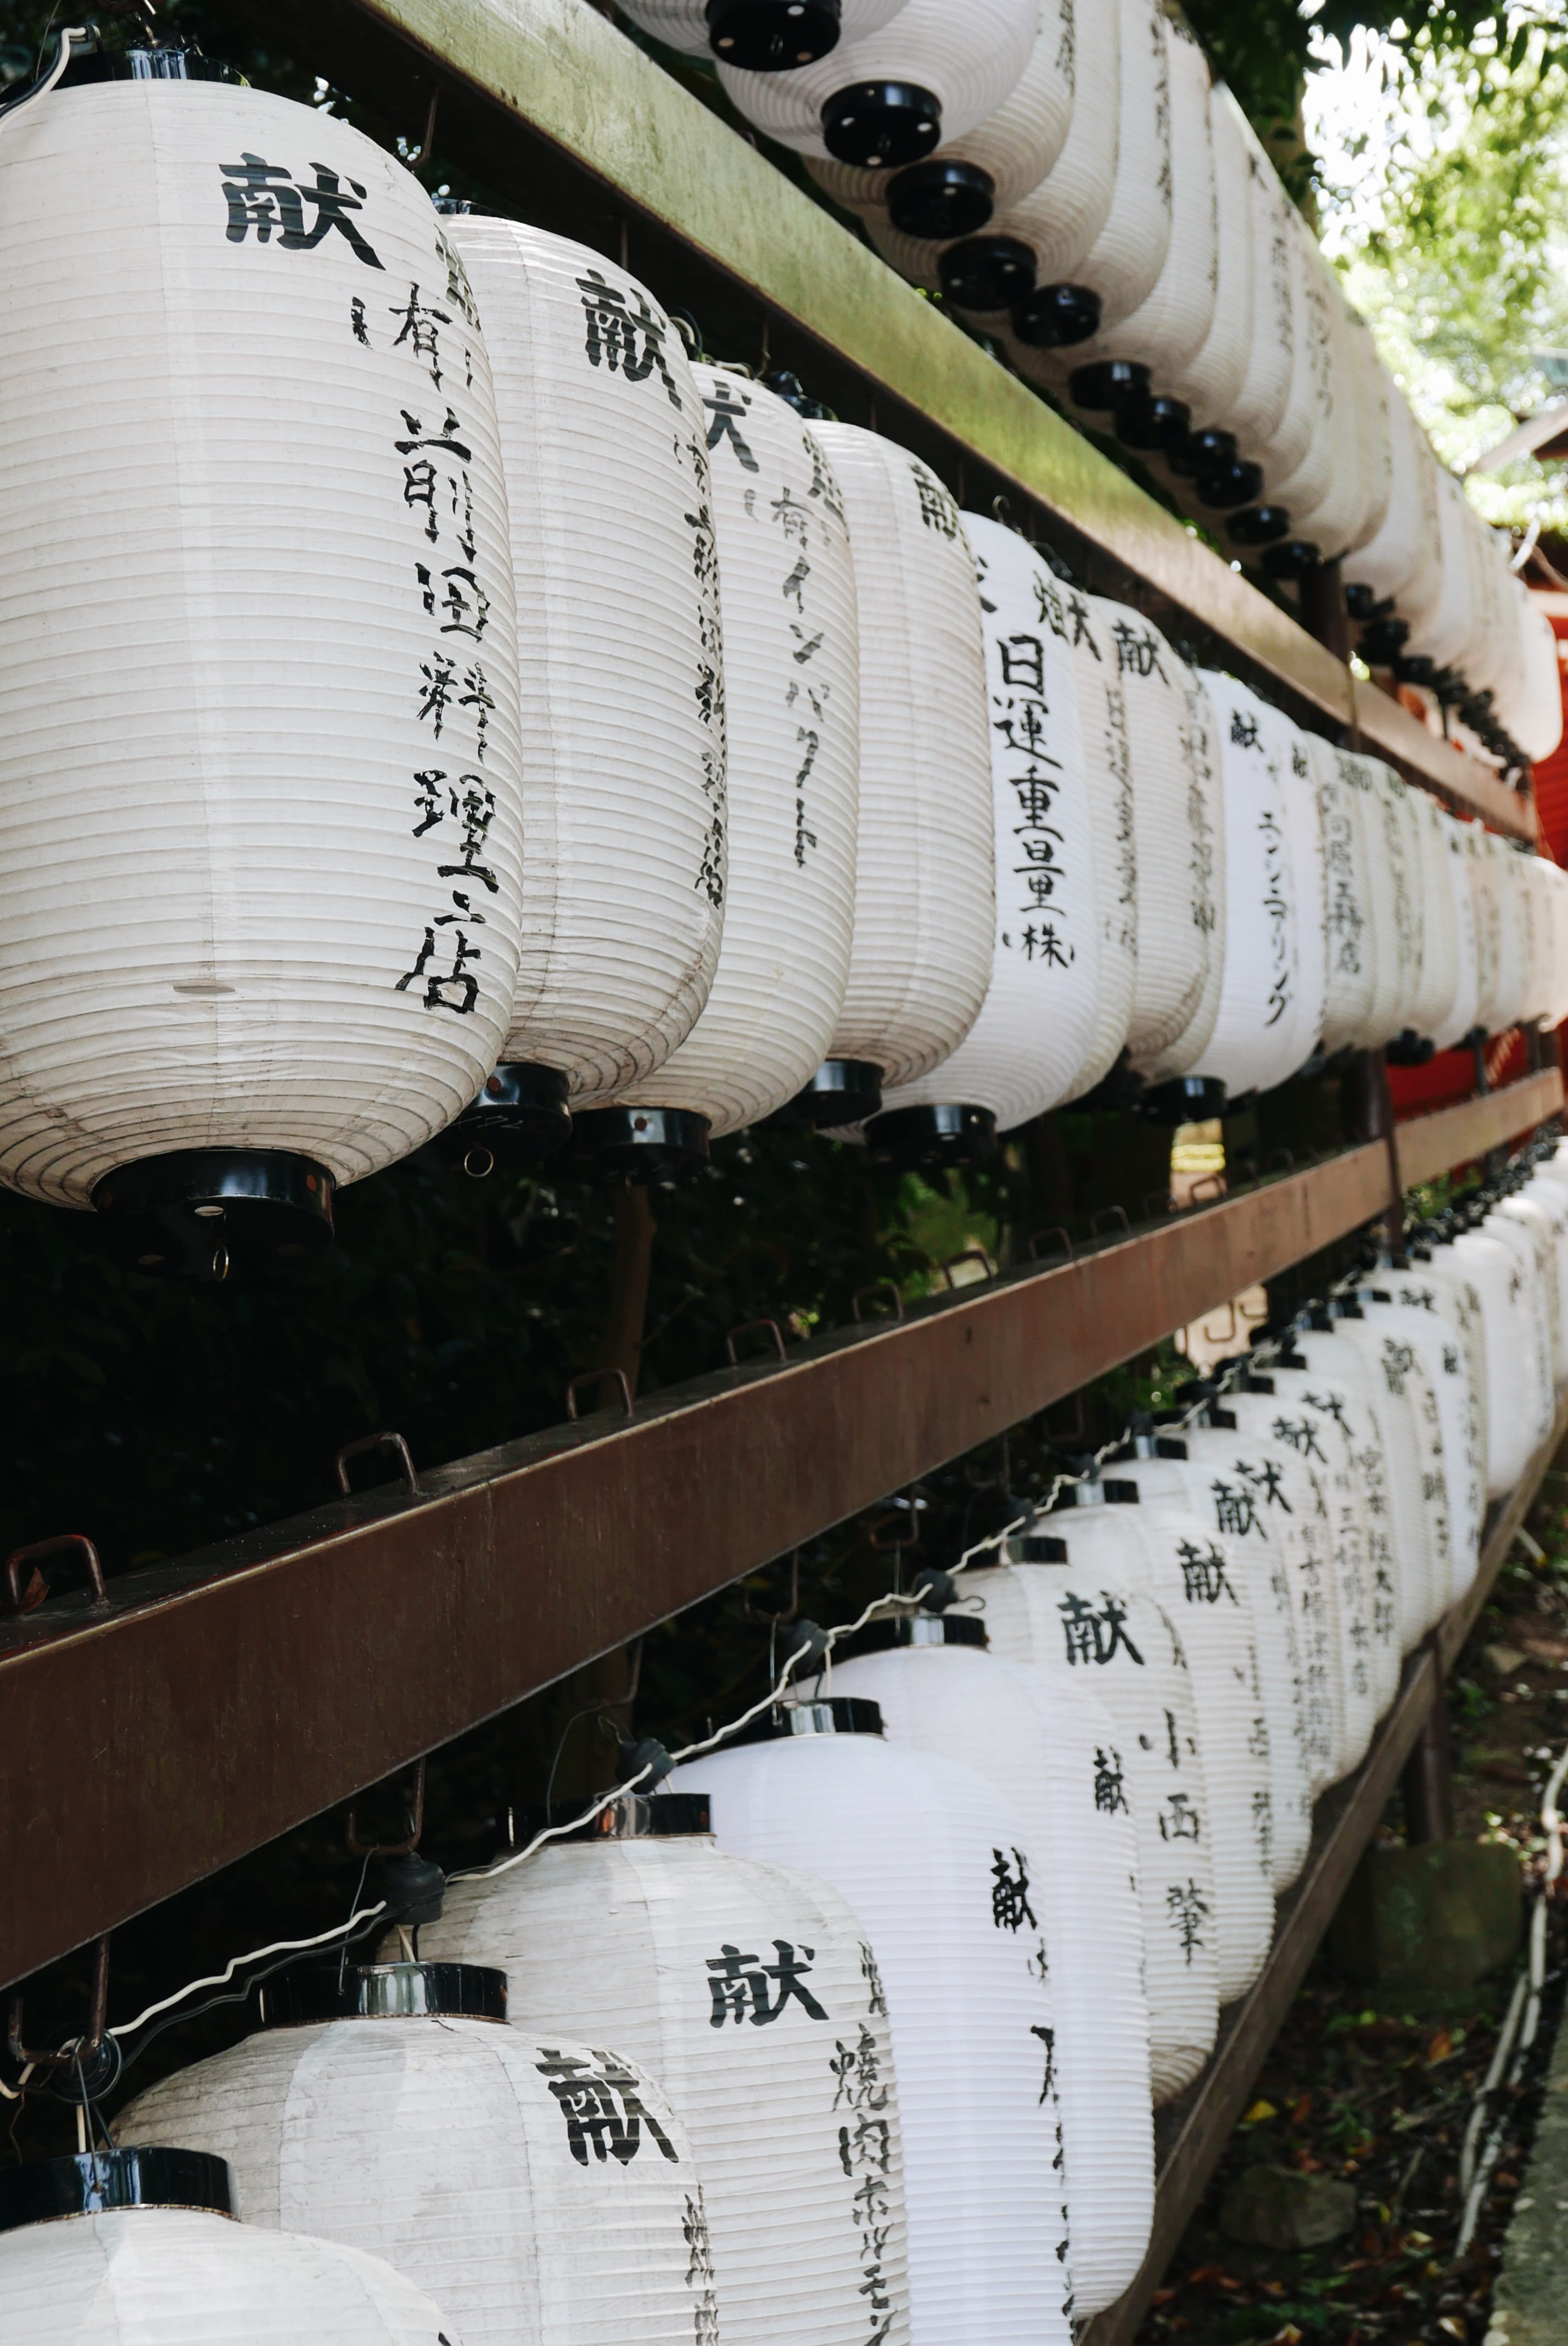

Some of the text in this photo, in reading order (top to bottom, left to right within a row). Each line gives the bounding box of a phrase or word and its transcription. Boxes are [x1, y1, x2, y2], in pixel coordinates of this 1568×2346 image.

[220, 152, 385, 270] 献
[575, 269, 682, 411] 献
[1112, 617, 1170, 686] 献
[1210, 1478, 1269, 1540] 献
[1175, 1536, 1239, 1605] 献
[1057, 1590, 1145, 1666] 献
[990, 1845, 1039, 1934] 献
[705, 1939, 830, 2029] 献
[531, 2047, 679, 2166] 献
